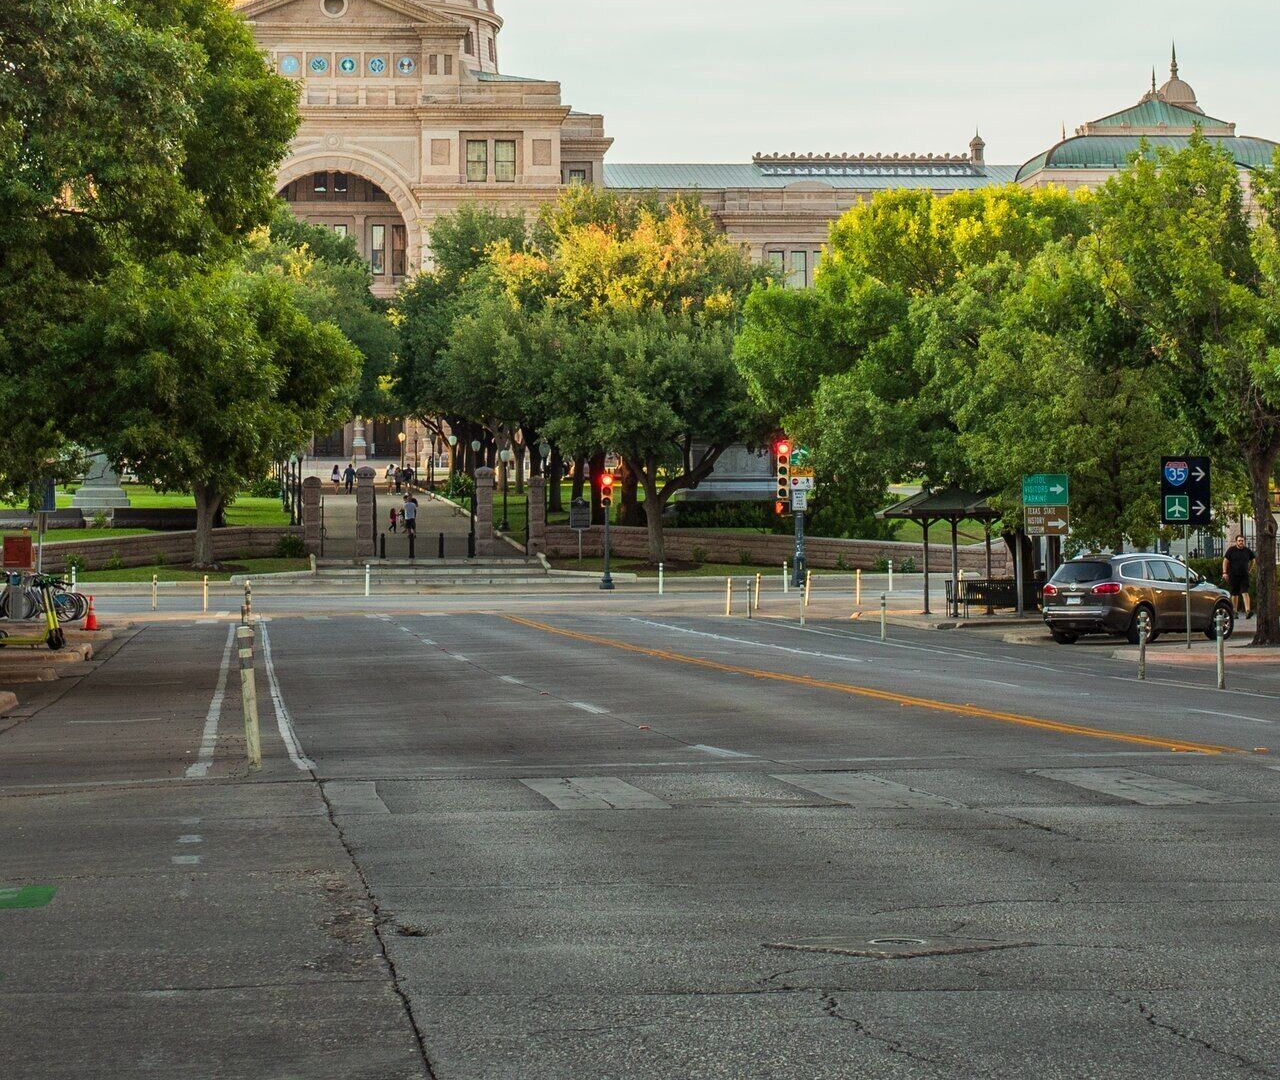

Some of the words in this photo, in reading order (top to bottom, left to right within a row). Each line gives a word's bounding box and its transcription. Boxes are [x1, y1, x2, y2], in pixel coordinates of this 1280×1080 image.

[1168, 467, 1185, 481] 35
[1024, 476, 1046, 484] CAPITOL
[1024, 485, 1048, 493] VISITORS
[1027, 507, 1041, 515] TEXAS
[1043, 507, 1056, 515] STATE
[1027, 516, 1045, 525] HISTORY
[1027, 526, 1045, 534] MUSEUM
